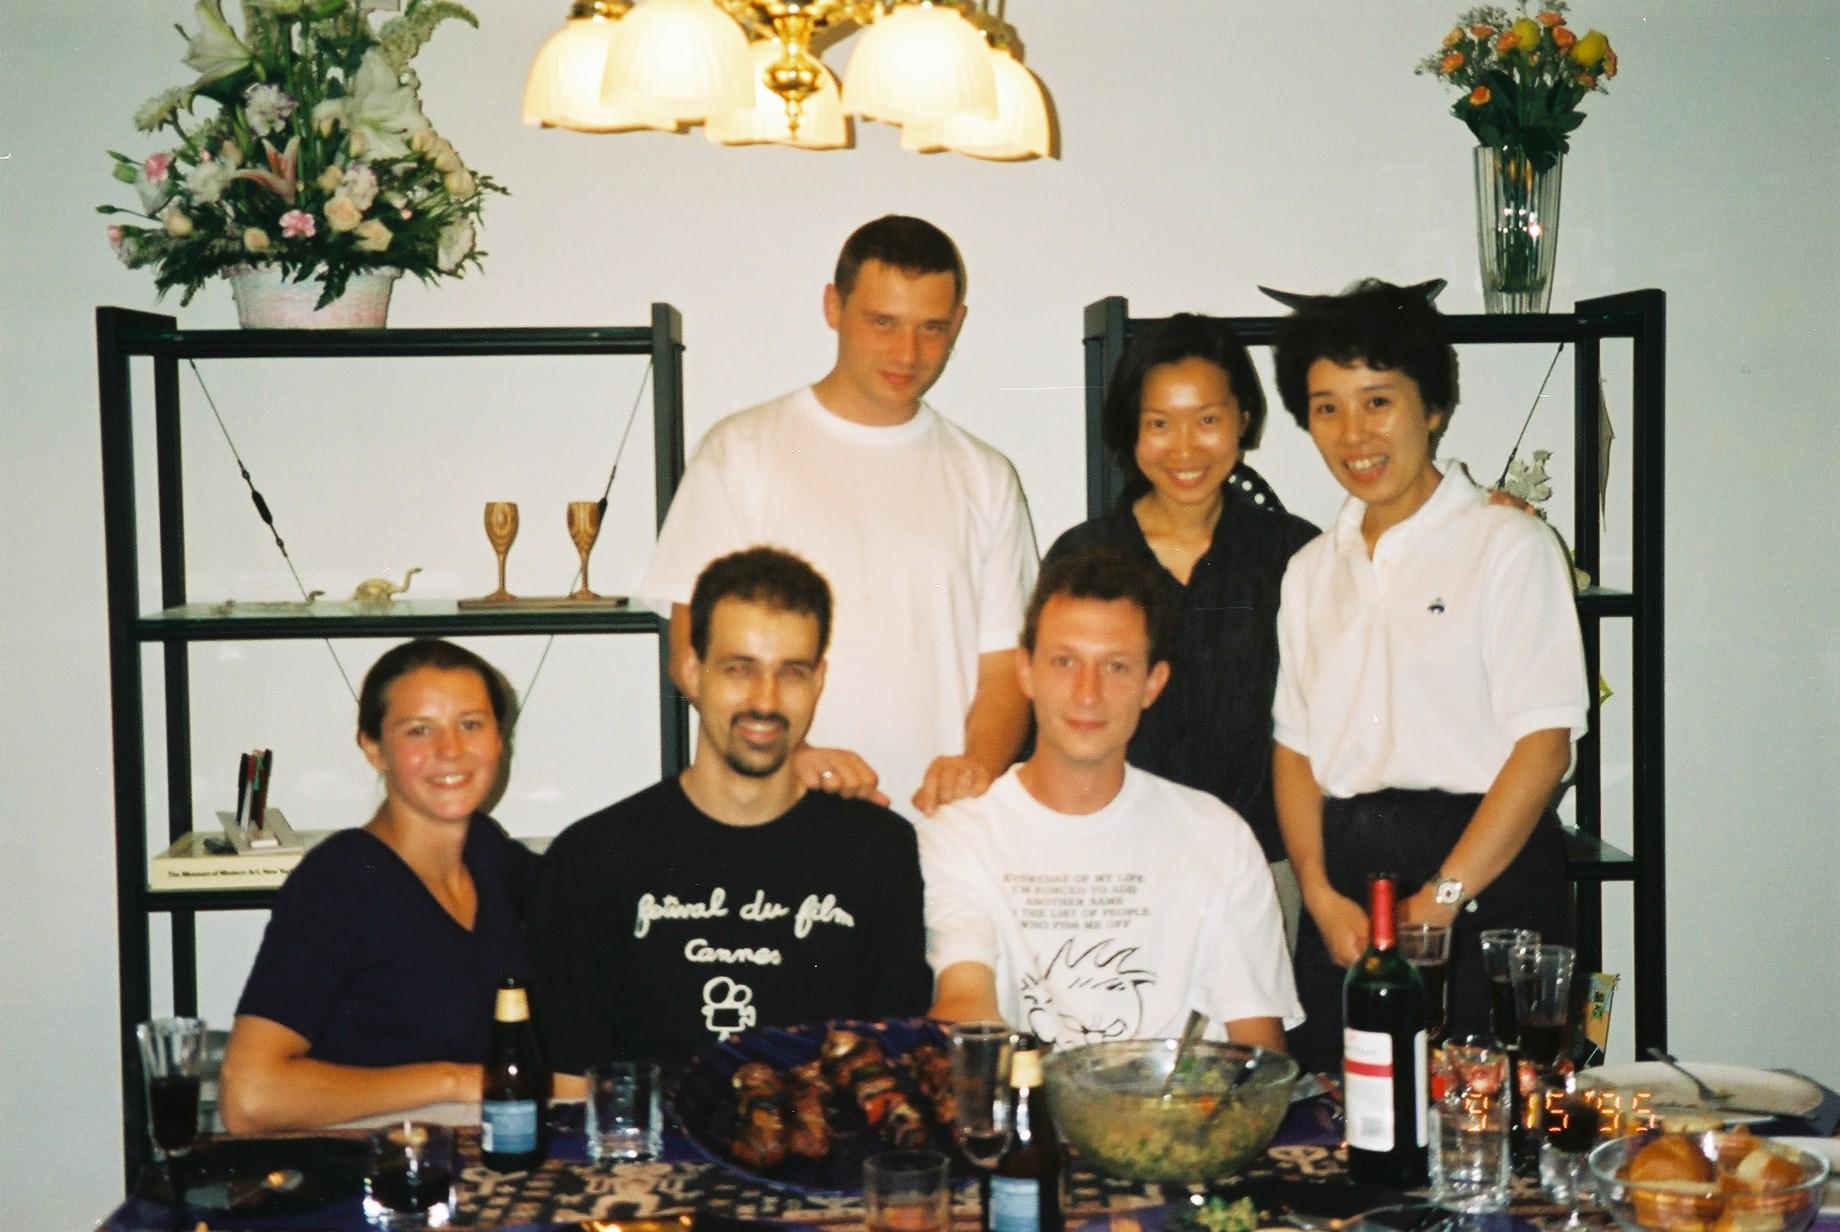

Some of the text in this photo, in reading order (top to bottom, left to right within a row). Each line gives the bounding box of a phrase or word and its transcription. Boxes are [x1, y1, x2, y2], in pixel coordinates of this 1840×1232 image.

[1073, 873, 1090, 883] OF
[1094, 873, 1112, 883] MY
[1117, 873, 1144, 882] LIFE
[739, 889, 790, 921] du
[1021, 908, 1045, 917] THE
[1051, 908, 1076, 917] LIST
[1081, 908, 1097, 917] OF
[1102, 907, 1150, 916] PEOPLE
